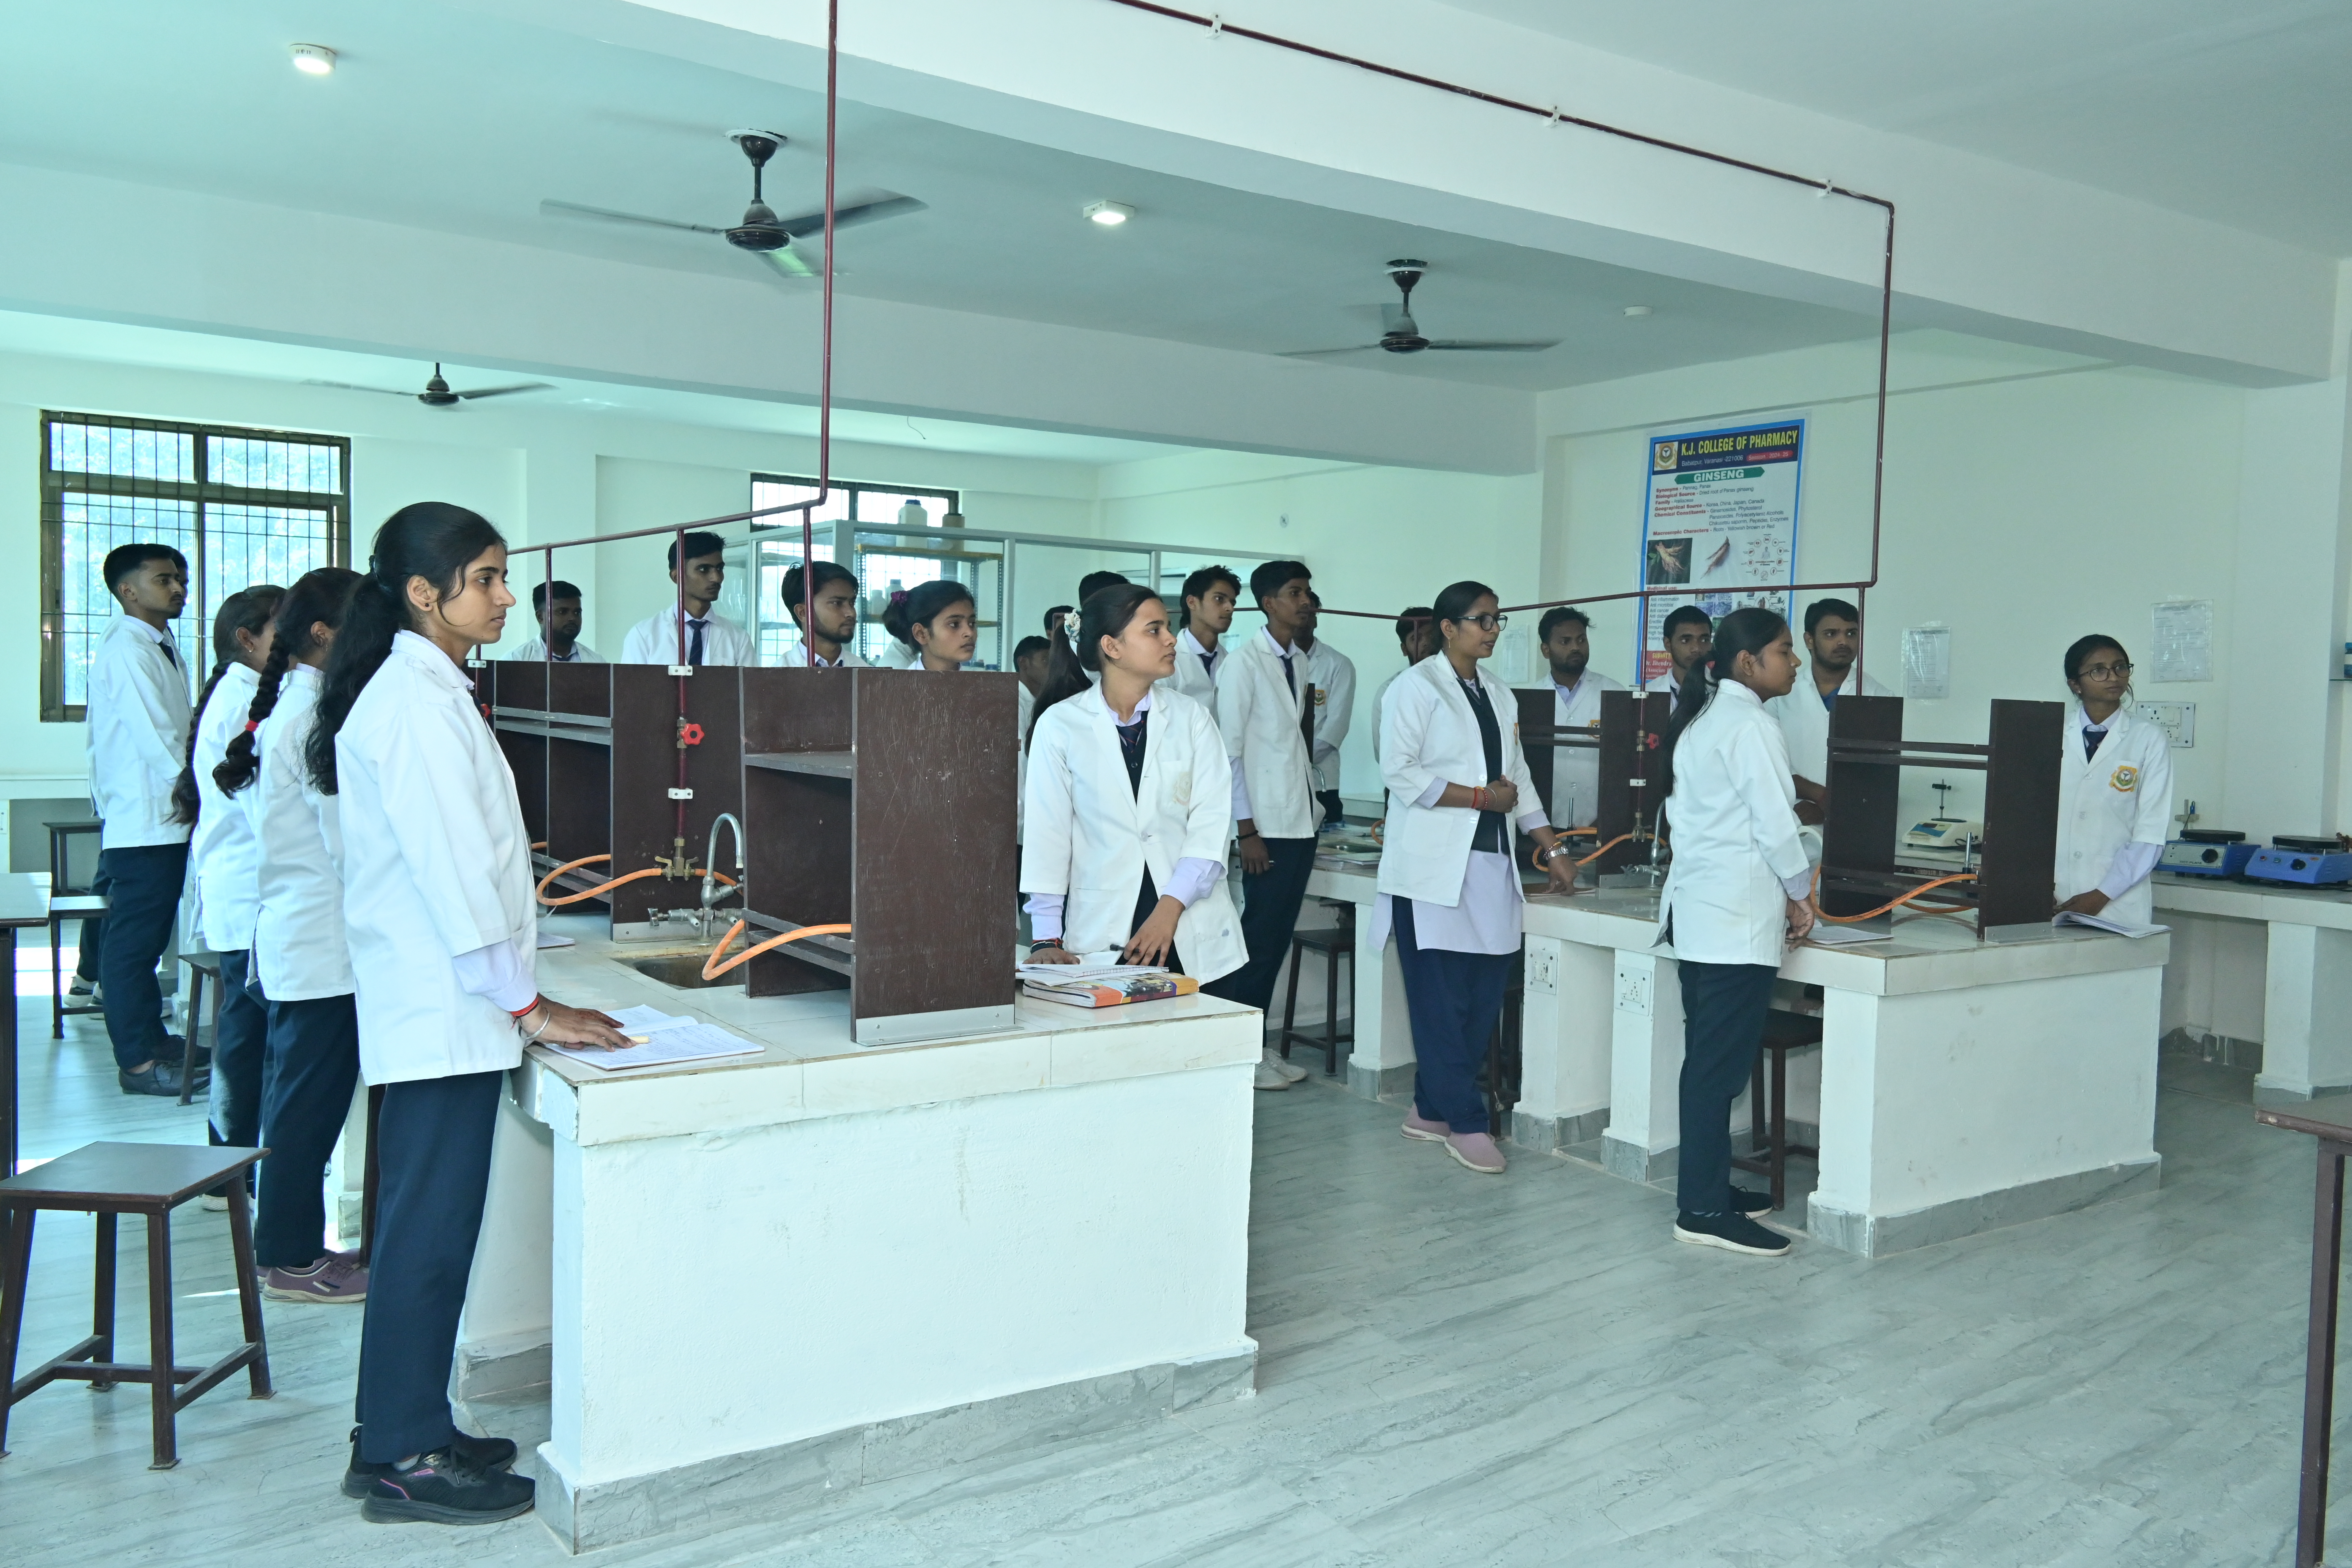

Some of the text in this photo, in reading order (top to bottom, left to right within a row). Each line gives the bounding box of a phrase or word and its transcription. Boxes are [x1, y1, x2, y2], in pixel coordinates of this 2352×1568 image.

[1681, 430, 1798, 455] K.J. COLLEGE OF PHARMACY
[1693, 469, 1744, 482] GINSENG
